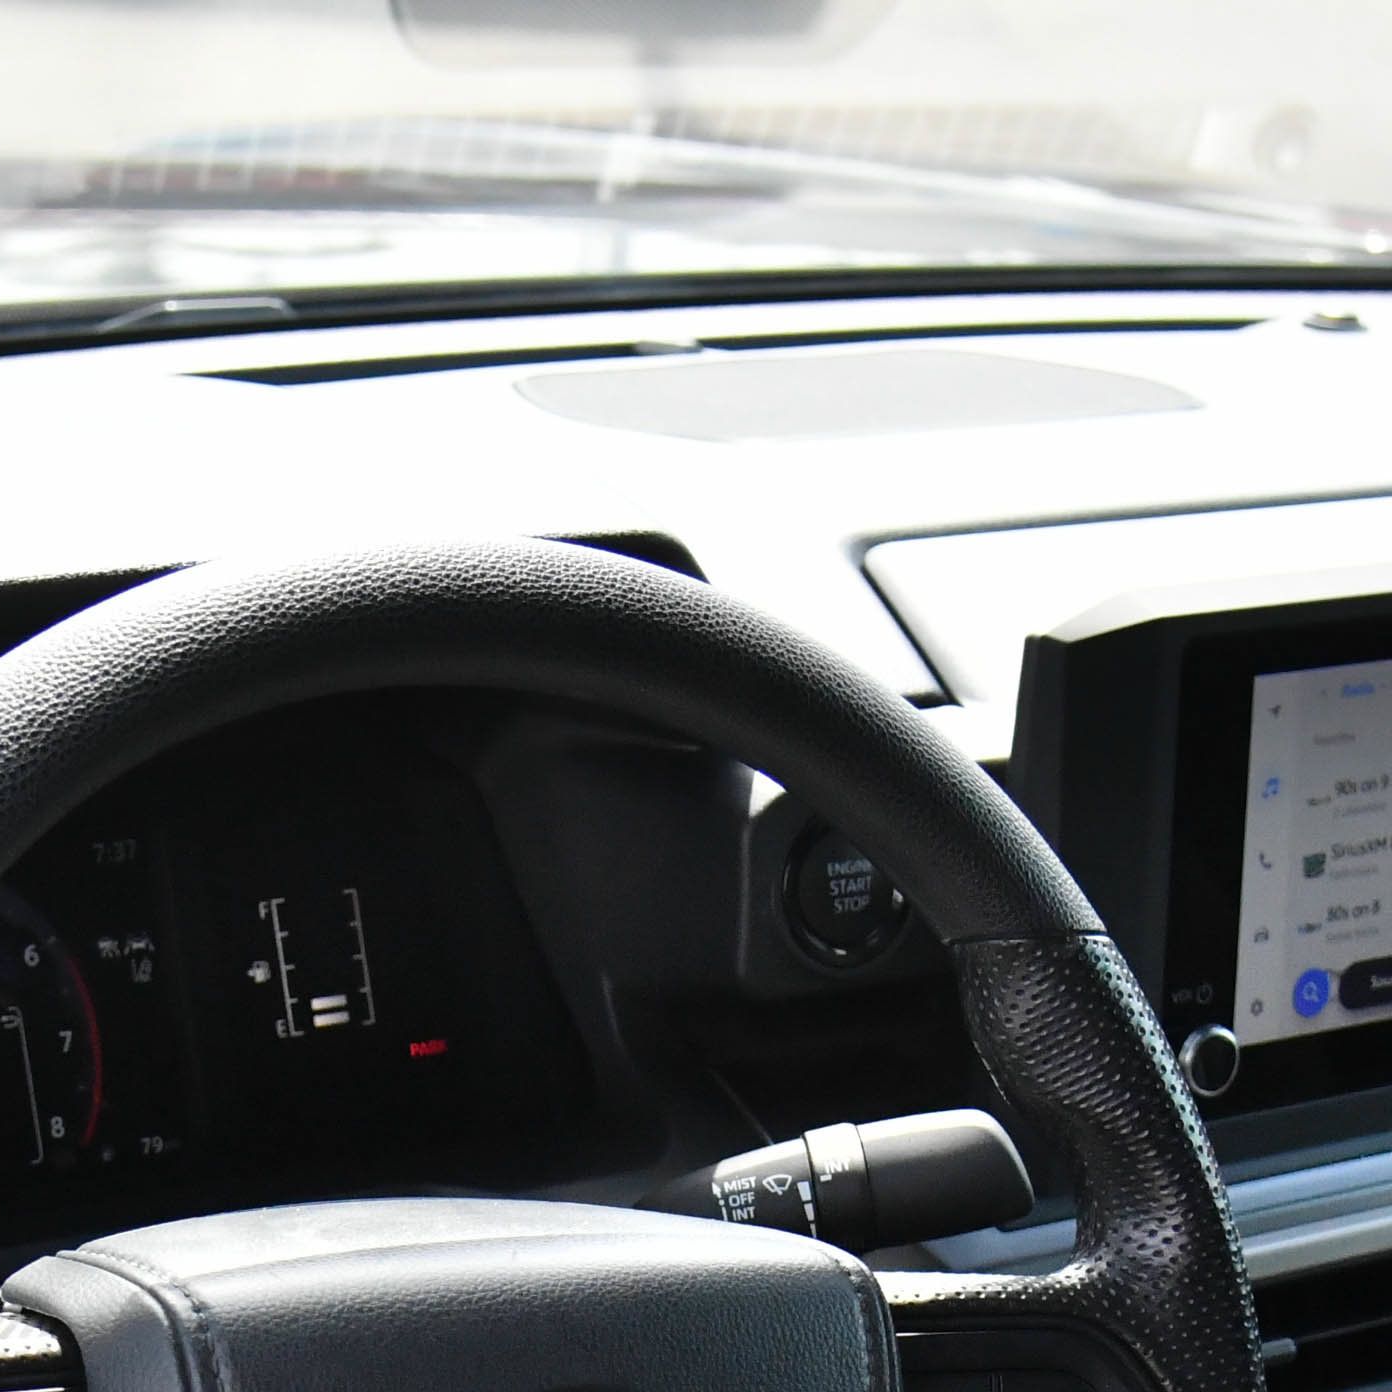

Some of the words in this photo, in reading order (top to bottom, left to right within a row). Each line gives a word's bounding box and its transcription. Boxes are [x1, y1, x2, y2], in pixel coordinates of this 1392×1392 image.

[829, 875, 872, 897] START
[258, 900, 270, 921] F
[833, 896, 871, 914] STOP
[23, 944, 41, 968] 6
[275, 1018, 290, 1039] E
[59, 1029, 73, 1053] 7
[49, 1115, 66, 1139] 8
[824, 1158, 852, 1176] INT
[723, 1176, 757, 1194] MIST
[728, 1191, 755, 1208] OFF
[732, 1206, 756, 1222] INT
